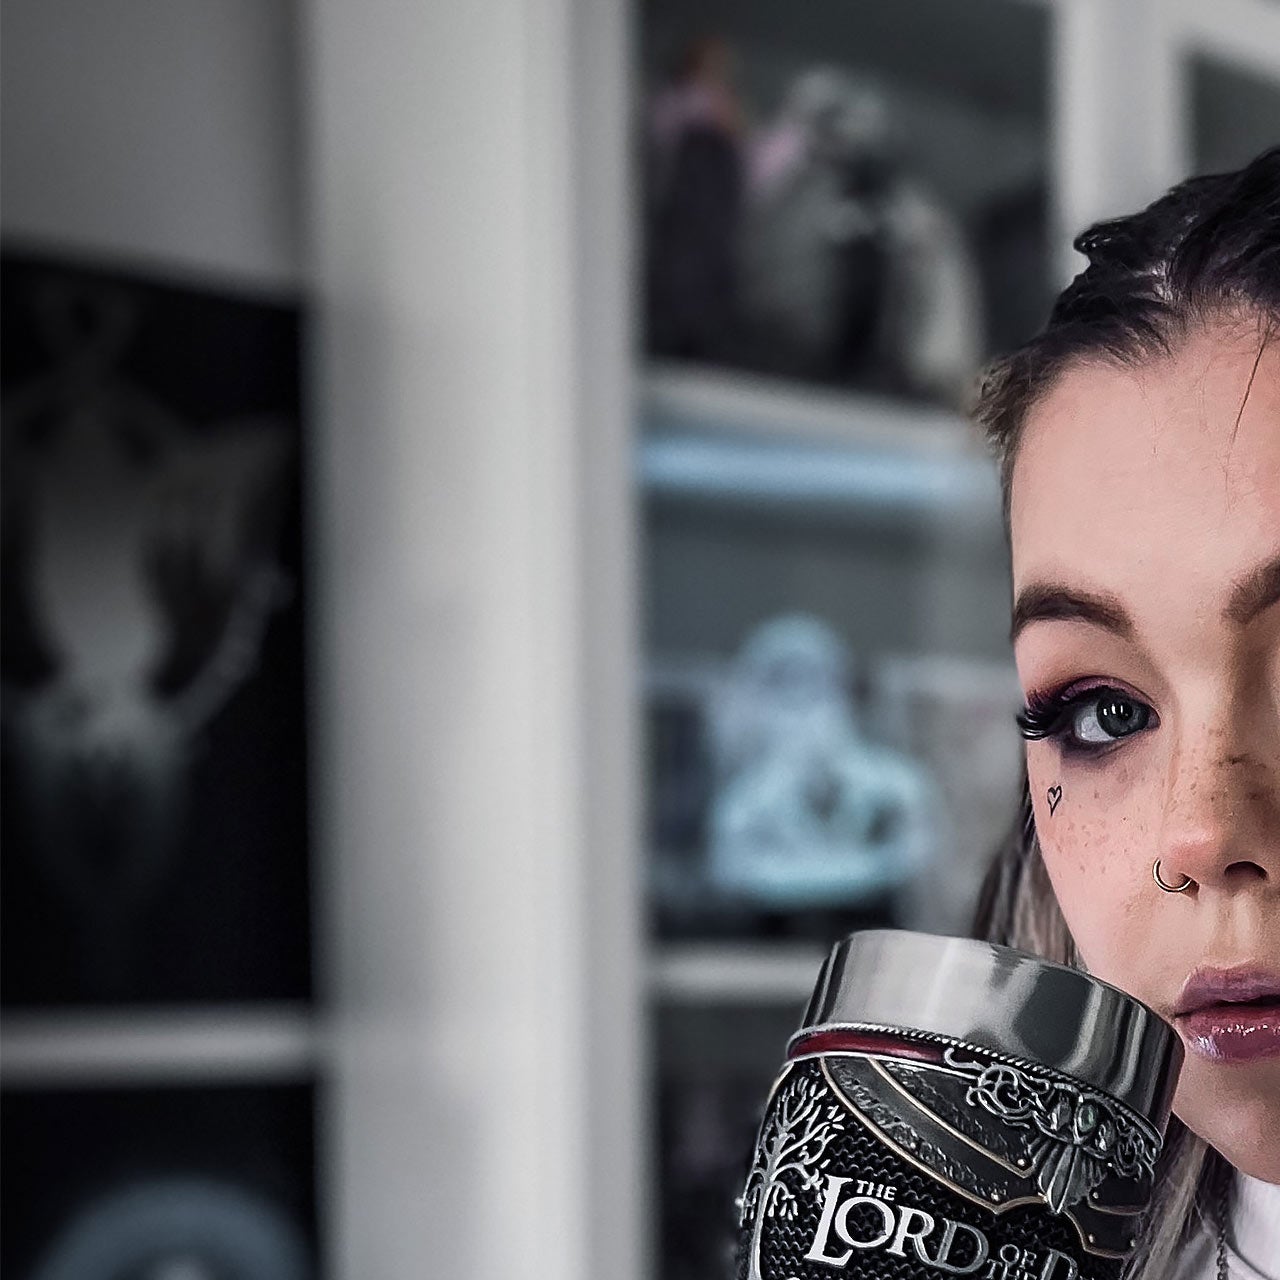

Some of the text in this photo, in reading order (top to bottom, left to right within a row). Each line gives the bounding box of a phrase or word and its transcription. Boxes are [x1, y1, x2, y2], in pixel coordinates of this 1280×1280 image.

[856, 1180, 897, 1200] THE
[804, 1174, 989, 1274] LORD
[1000, 1244, 1037, 1269] OF
